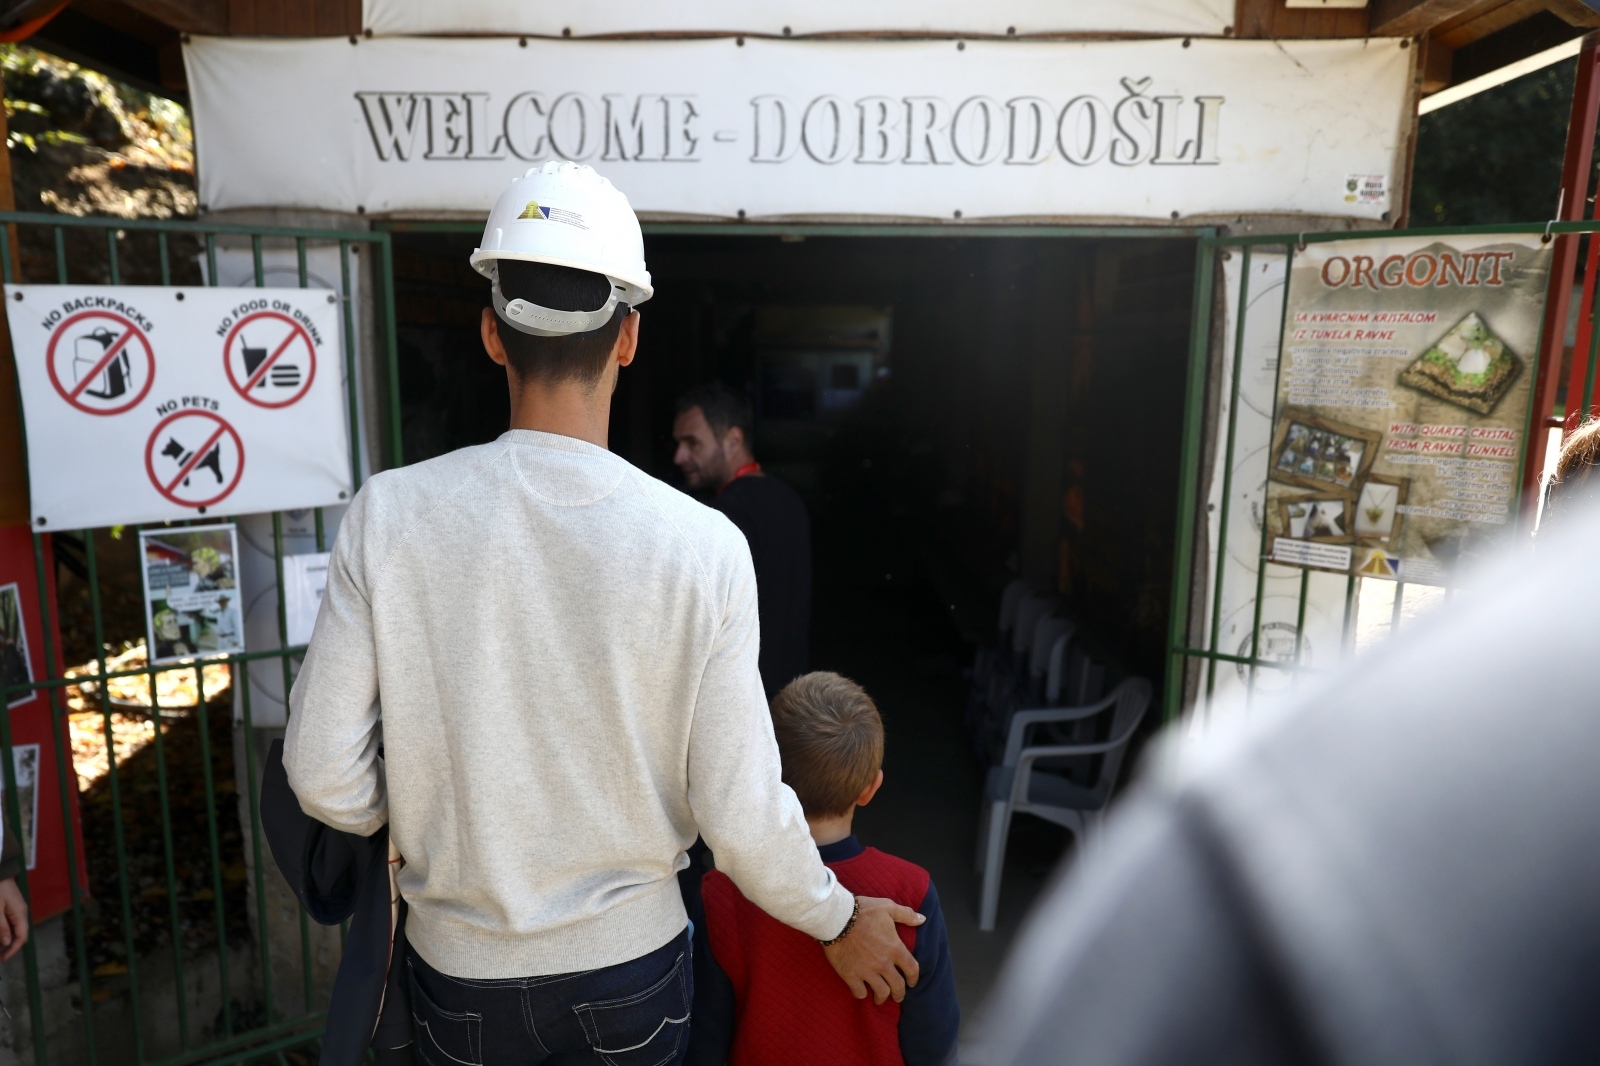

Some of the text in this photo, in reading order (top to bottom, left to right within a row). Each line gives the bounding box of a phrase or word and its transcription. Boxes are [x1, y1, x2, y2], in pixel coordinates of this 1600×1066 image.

[353, 90, 702, 162] WELCOME
[749, 76, 1226, 166] DOBRODOŠLI
[1321, 251, 1513, 290] ORGONIT
[41, 296, 154, 333] NO BACKPACKS
[216, 299, 324, 347] NO FOOD OR DRINK
[1310, 313, 1370, 323] KVARCNIM
[1372, 313, 1437, 323] KRISTALOM
[1310, 329, 1352, 340] TUNELA
[156, 396, 219, 416] NO PETS
[1390, 424, 1515, 440] WITH QUARTZ CRYSTAL
[1387, 439, 1418, 450] FROM
[1467, 443, 1516, 457] TUNNELS
